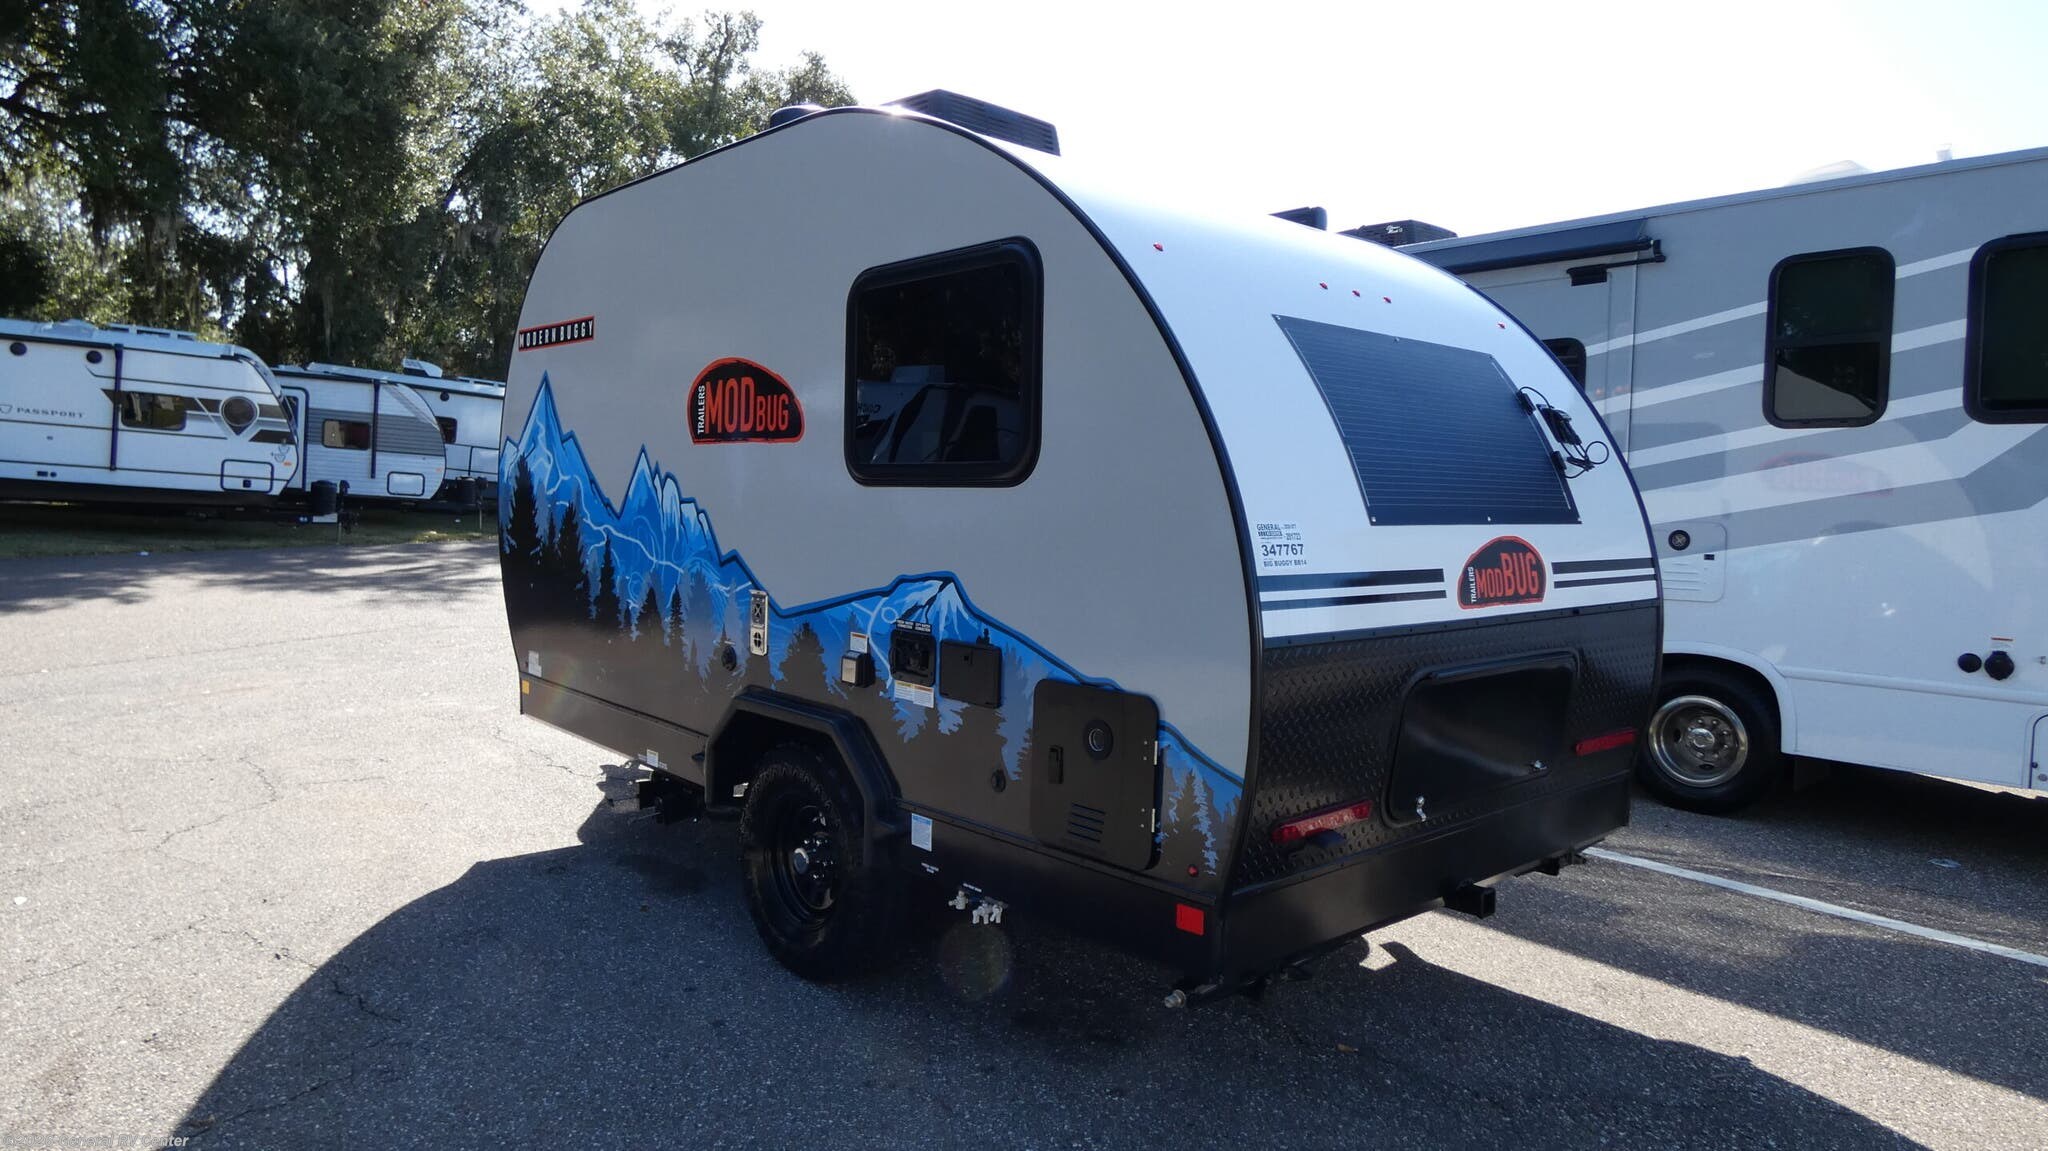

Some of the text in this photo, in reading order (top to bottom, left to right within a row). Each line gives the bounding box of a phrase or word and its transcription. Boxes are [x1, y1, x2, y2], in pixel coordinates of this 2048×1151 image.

[519, 320, 593, 348] MODERN BUGGY
[16, 407, 85, 419] PASSPORT
[697, 384, 706, 435] TRAILERS
[1256, 523, 1281, 531] GENERAL
[1261, 543, 1304, 557] 347767
[1274, 559, 1293, 567] BUGGY
[1467, 566, 1477, 603] TRAILERS
